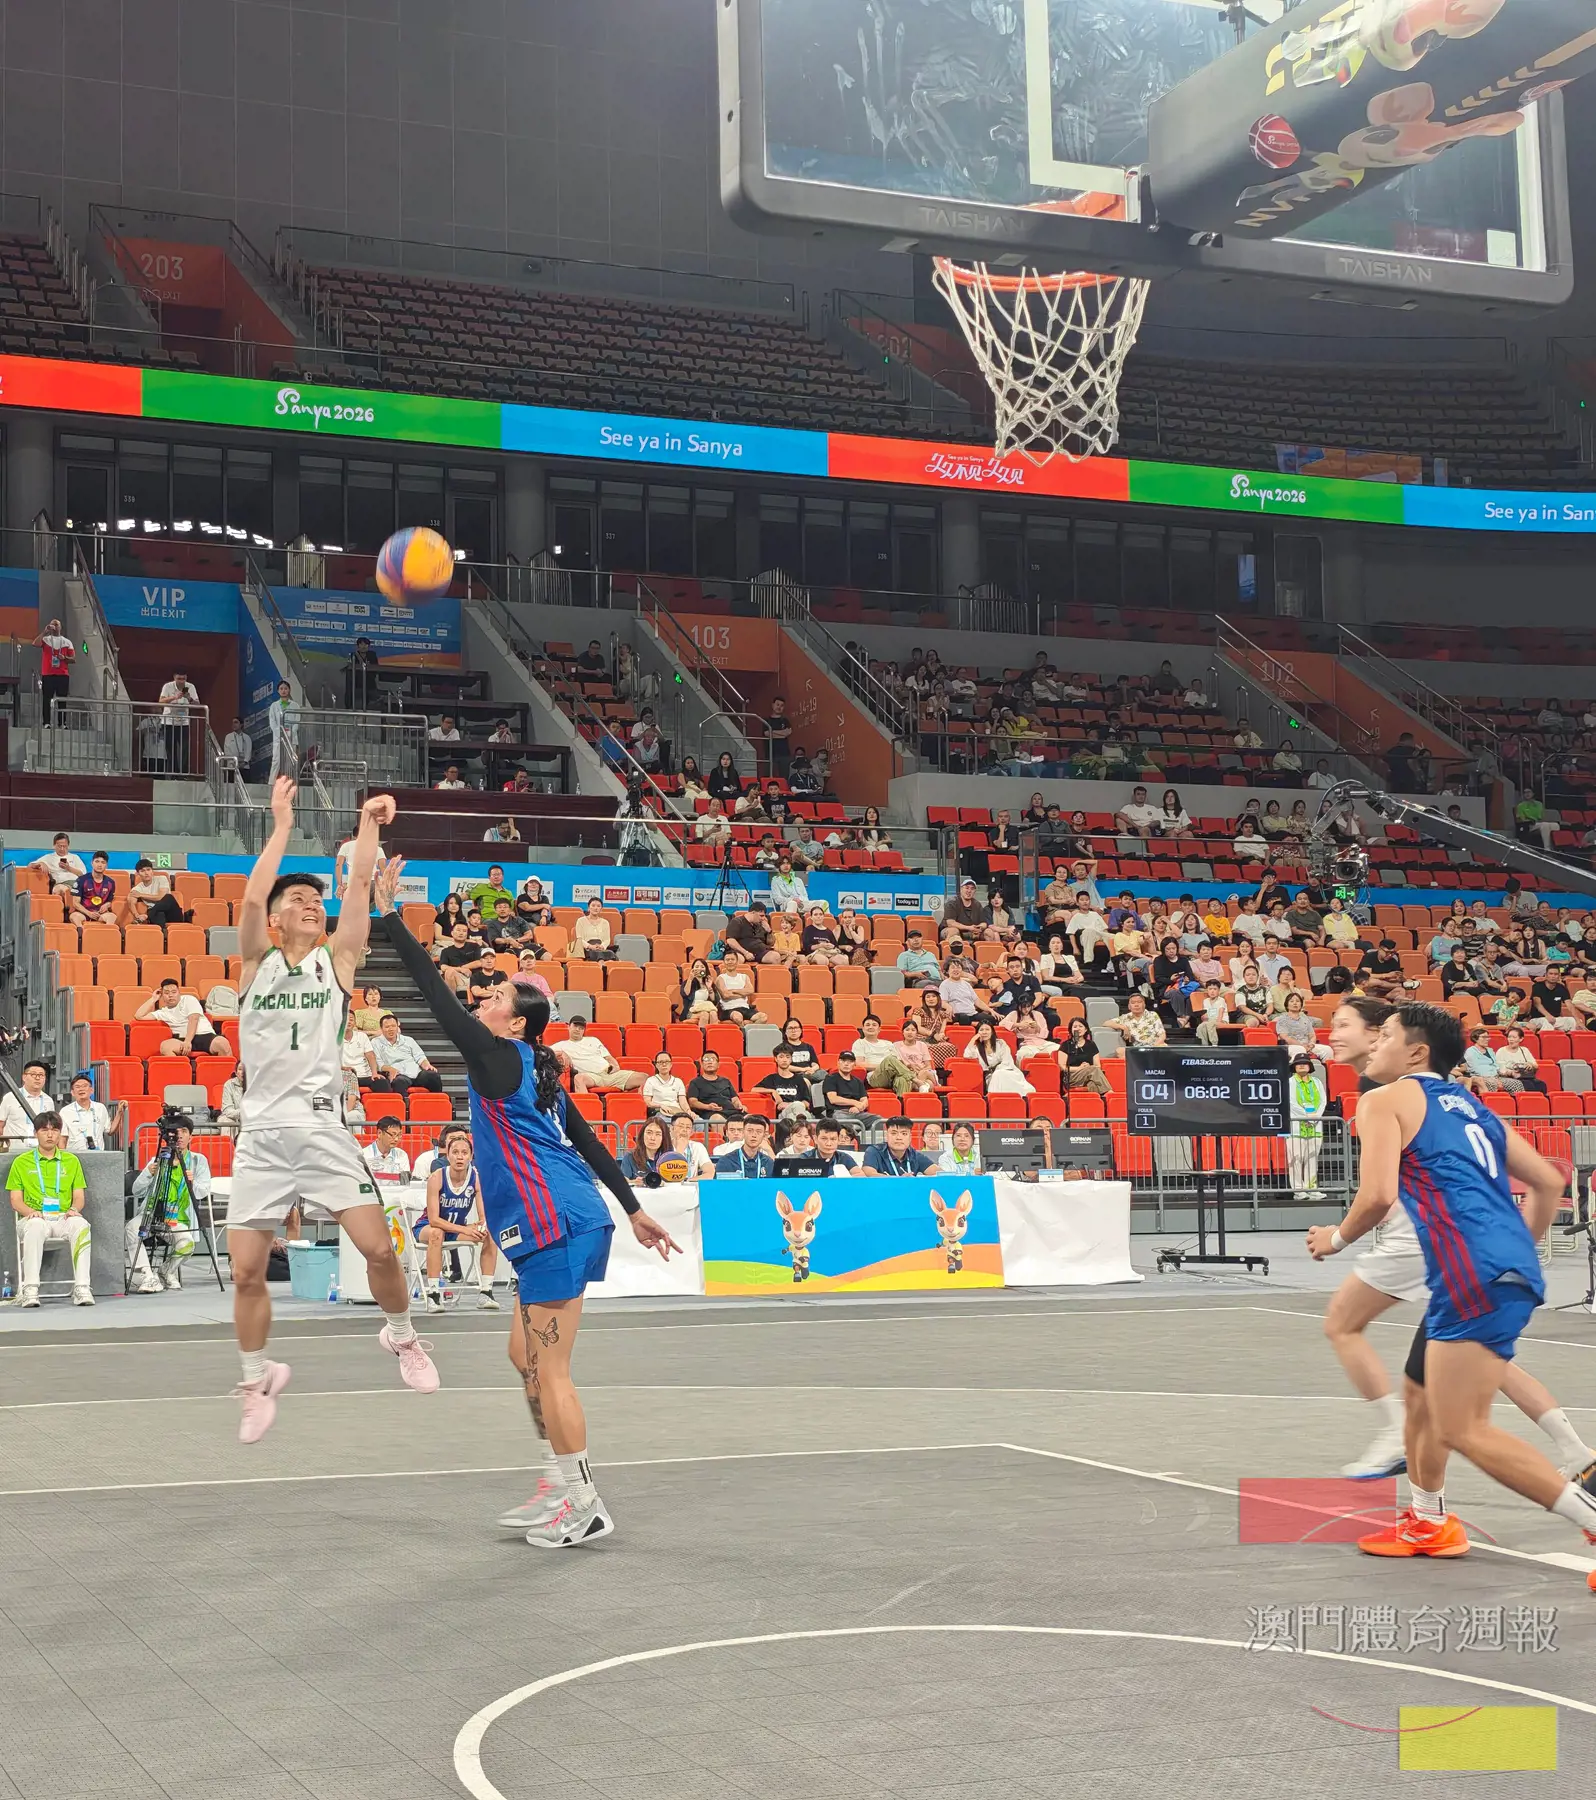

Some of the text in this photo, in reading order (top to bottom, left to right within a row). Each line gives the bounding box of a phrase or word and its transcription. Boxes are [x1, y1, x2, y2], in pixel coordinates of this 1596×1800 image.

[918, 205, 1026, 234] TAISHAN
[140, 253, 184, 281] 203
[1338, 257, 1433, 282] TAISHAN
[275, 388, 374, 429] Sanya 2026
[600, 426, 743, 460] See ya in Sanya
[1230, 474, 1306, 511] Sanya 2026
[1484, 502, 1596, 523] See ya in San
[142, 586, 186, 608] VIP
[141, 607, 186, 619] 出口 EXIT
[691, 625, 730, 650] 103
[712, 656, 728, 665] EXIT
[825, 734, 845, 751] 01-12
[291, 1022, 299, 1050] 1
[1141, 1083, 1169, 1100] 04
[1184, 1086, 1230, 1099] 06:02
[1247, 1083, 1272, 1100] 10
[1143, 1117, 1149, 1126] 1
[1268, 1117, 1275, 1126] 1
[1464, 1122, 1498, 1179] 0
